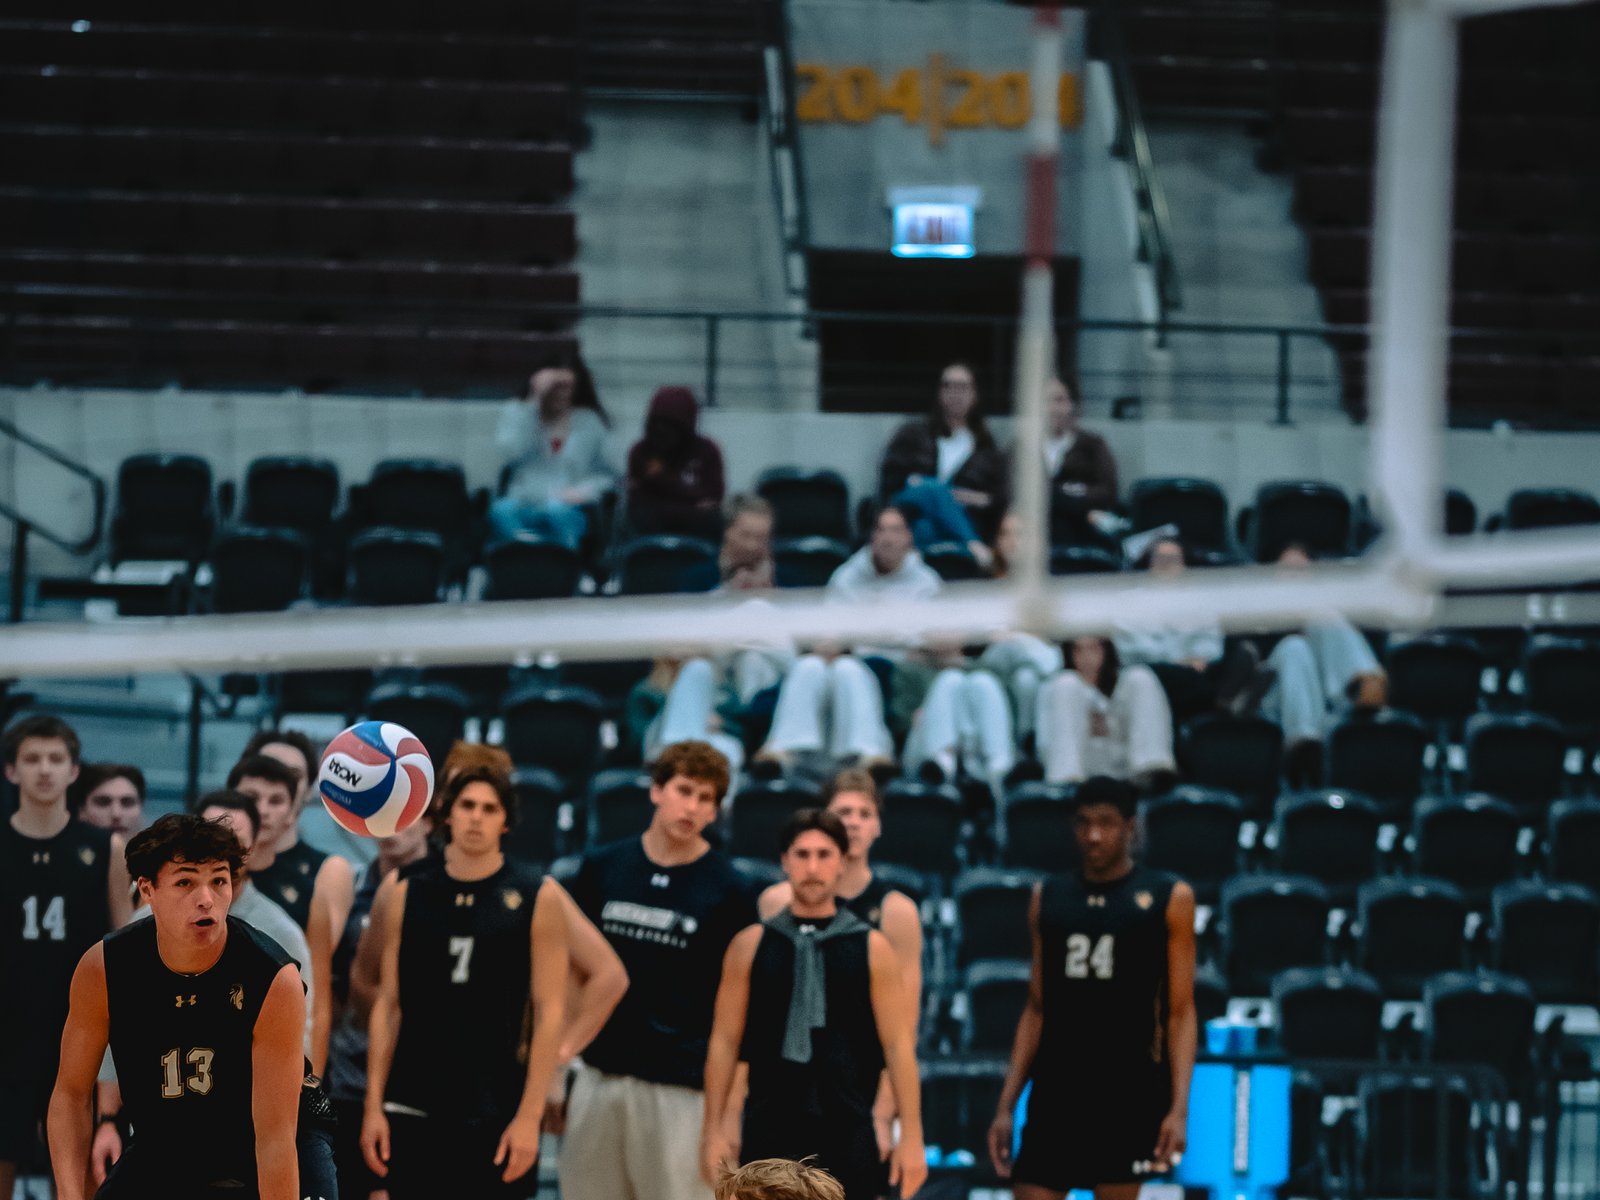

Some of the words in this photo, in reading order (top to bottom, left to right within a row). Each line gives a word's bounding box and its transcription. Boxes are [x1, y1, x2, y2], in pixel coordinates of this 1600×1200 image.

[328, 758, 362, 787] NCAA
[22, 895, 65, 939] 14
[449, 936, 474, 983] 7
[1065, 933, 1114, 978] 24
[161, 1047, 215, 1098] 13
